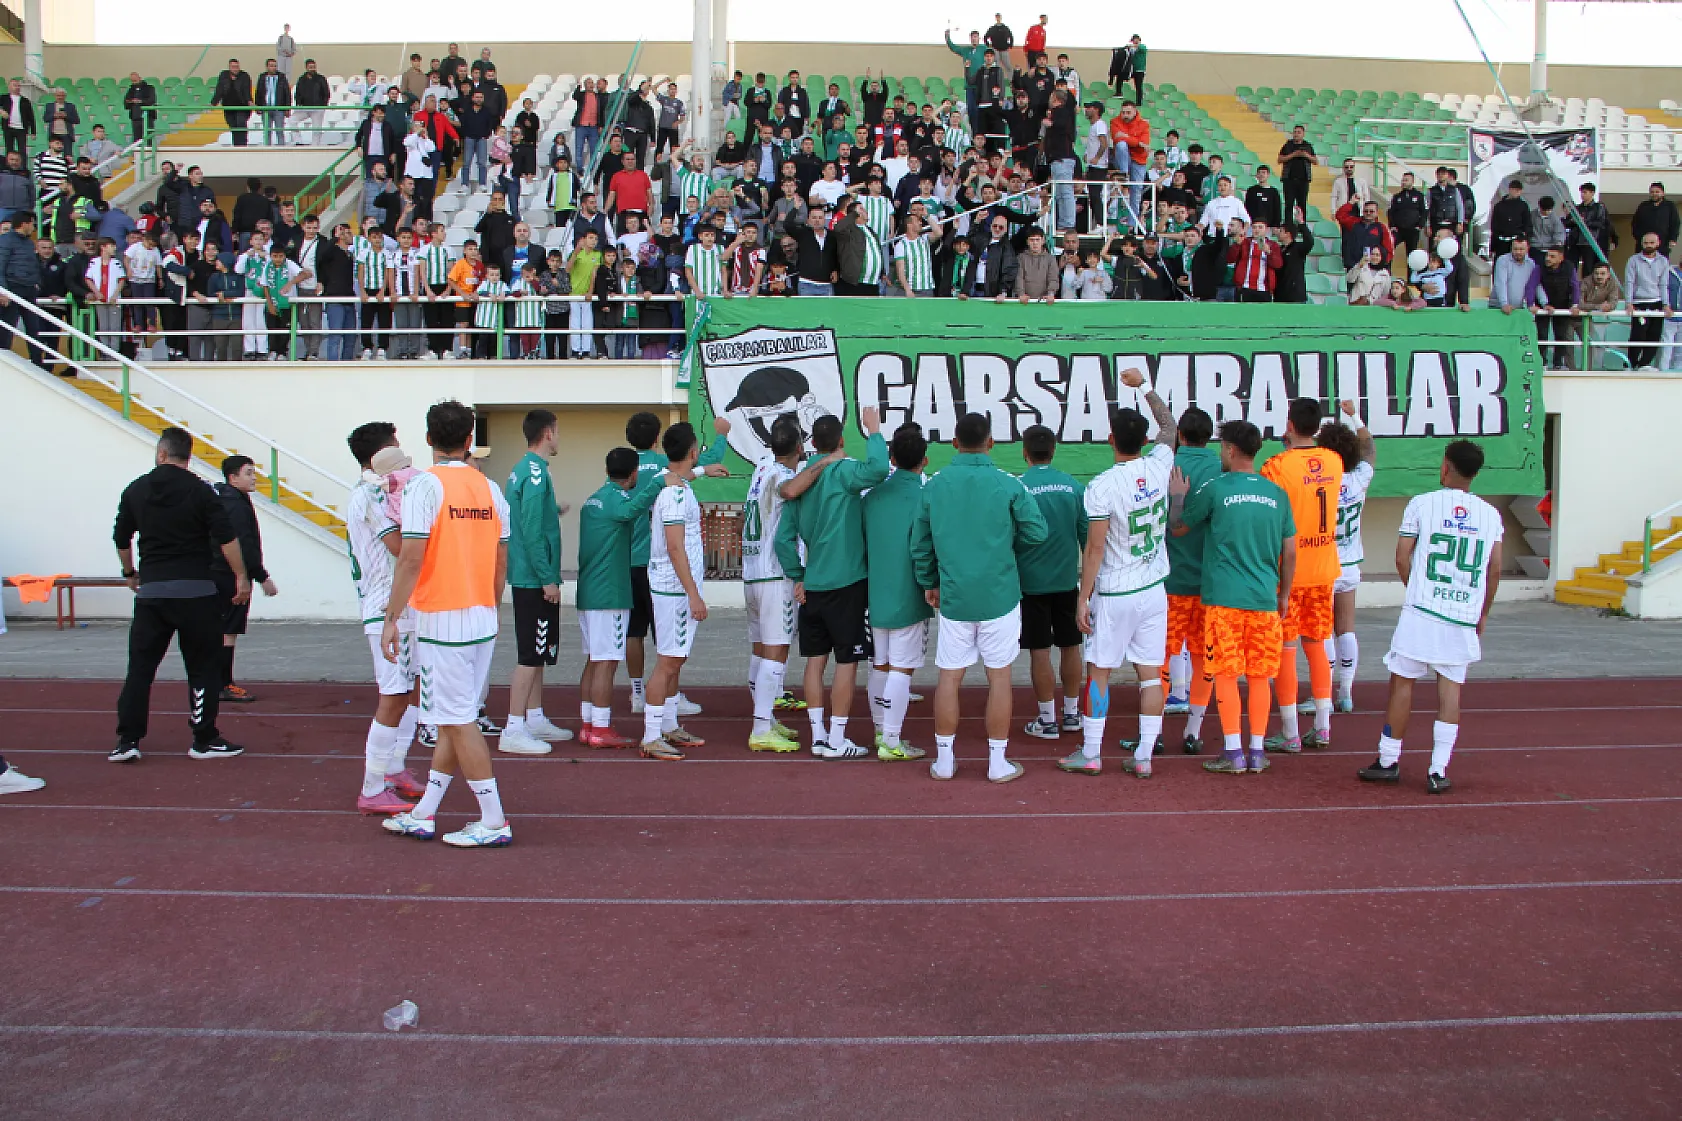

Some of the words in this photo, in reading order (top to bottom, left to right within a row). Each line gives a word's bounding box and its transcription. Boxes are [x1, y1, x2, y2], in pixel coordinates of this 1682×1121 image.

[448, 504, 493, 520] hummel
[1316, 487, 1327, 533] 1
[1426, 533, 1484, 588] 24
[1433, 586, 1471, 604] PEKER
